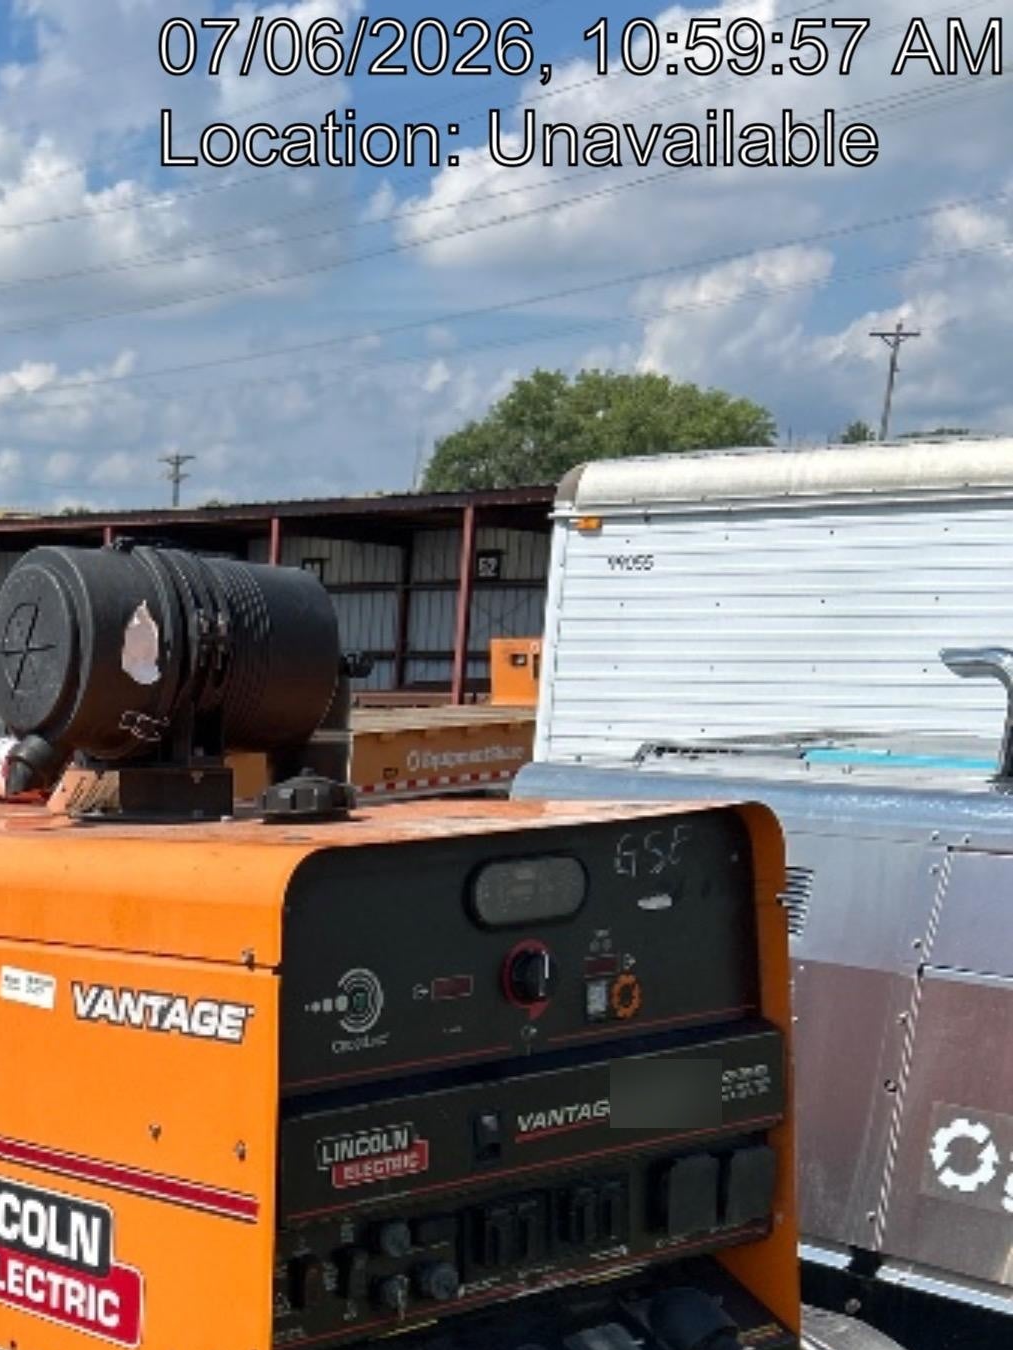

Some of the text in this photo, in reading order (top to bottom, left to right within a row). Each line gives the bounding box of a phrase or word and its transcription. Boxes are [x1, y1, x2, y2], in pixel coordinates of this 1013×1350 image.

[71, 981, 245, 1044] VANTAGE
[517, 1099, 611, 1132] VANTAG
[323, 1127, 408, 1165] LINCOLN
[344, 1151, 421, 1181] ELECTRIC
